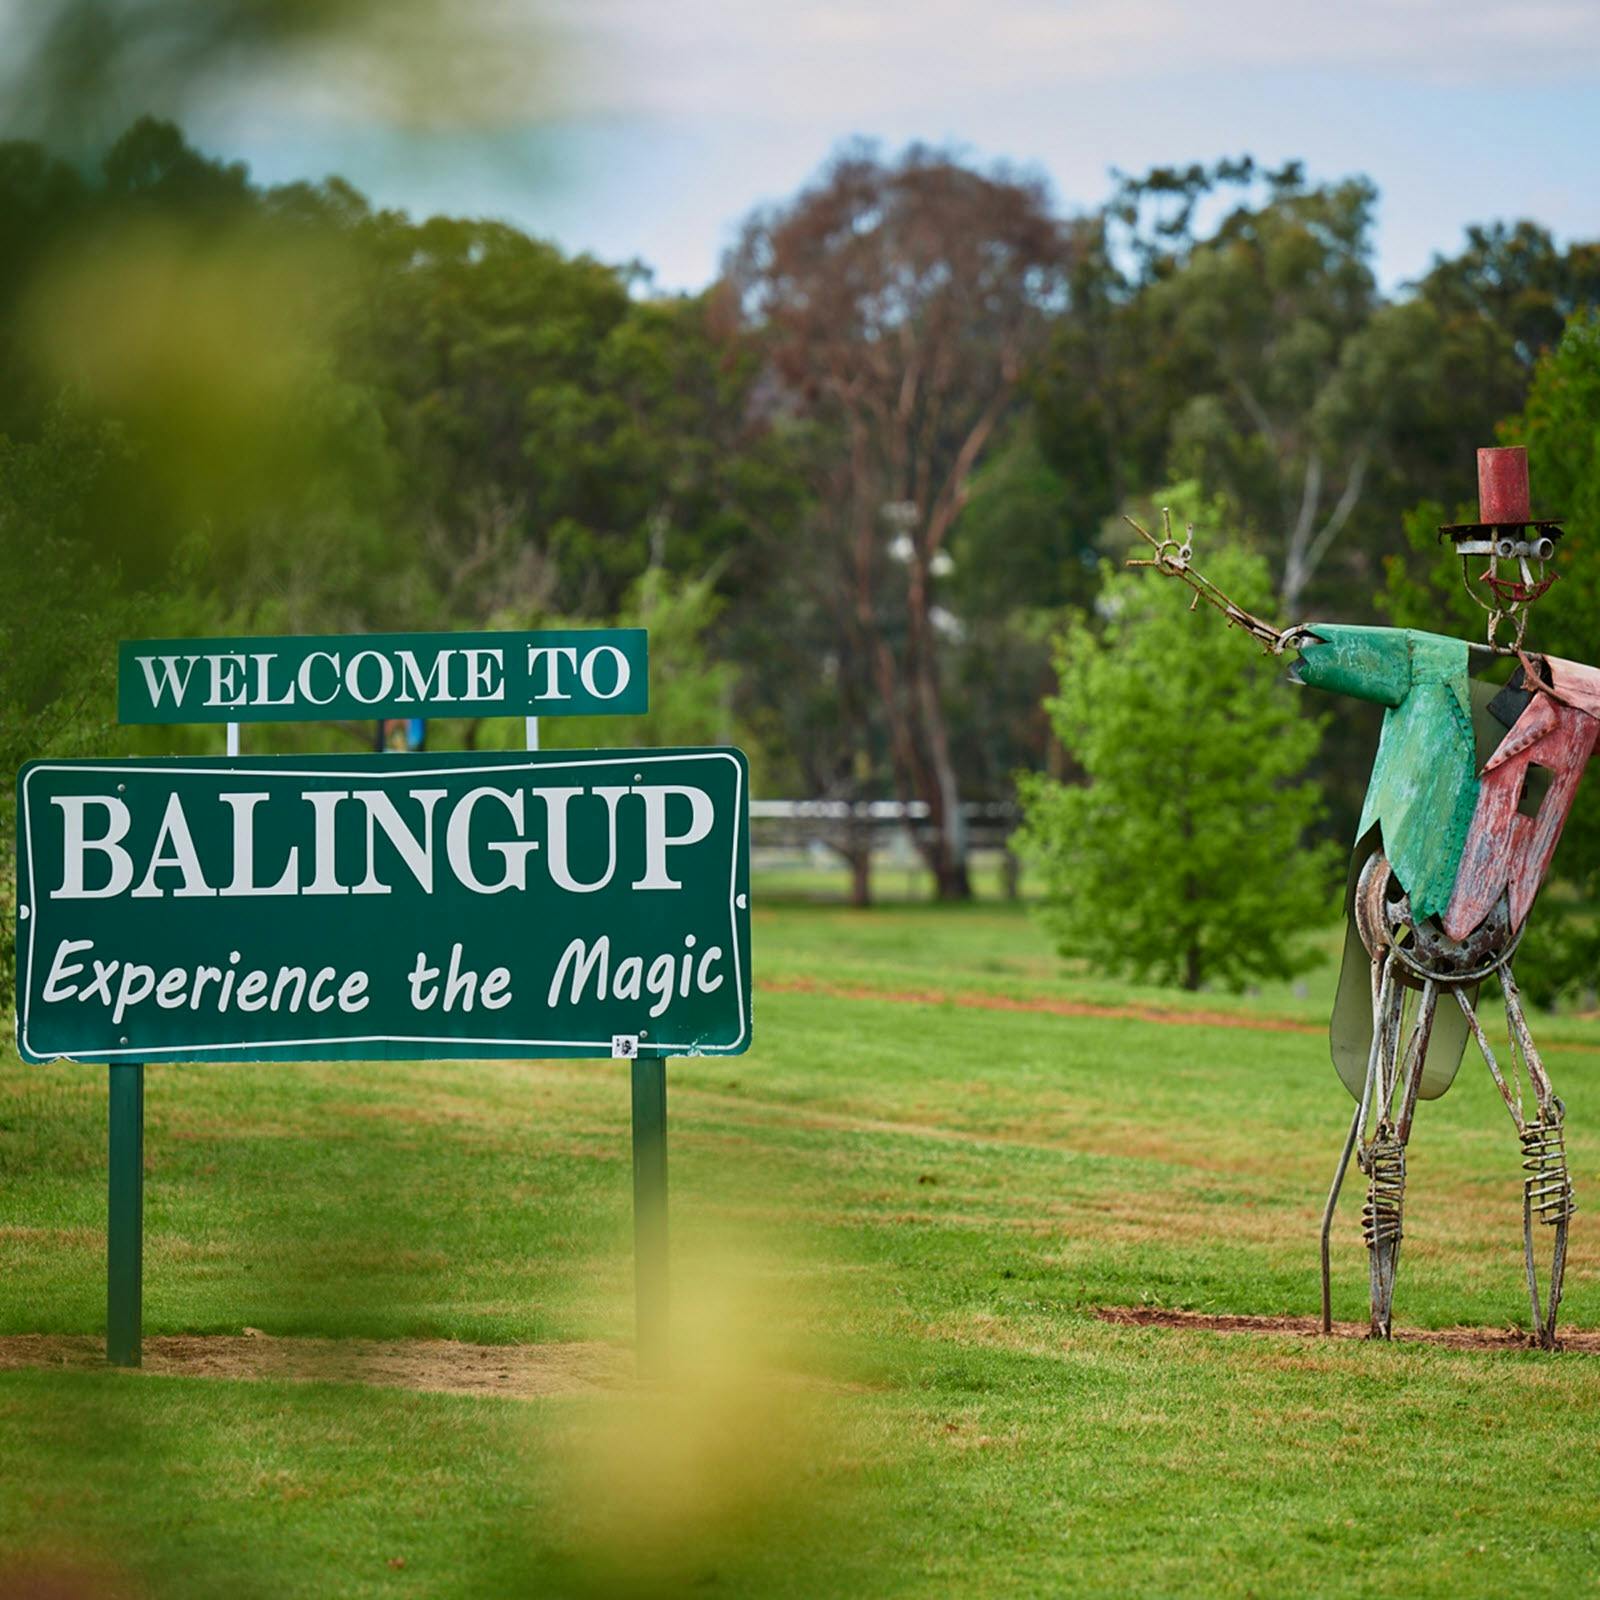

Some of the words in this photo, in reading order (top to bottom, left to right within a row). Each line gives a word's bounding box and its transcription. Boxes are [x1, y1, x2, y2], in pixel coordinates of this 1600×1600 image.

[135, 649, 505, 708] WELCOME
[528, 645, 631, 700] TO
[50, 785, 714, 899] BALINGUP
[42, 938, 370, 1025] Experience
[407, 942, 512, 1012] the
[547, 933, 724, 1018] Magic
